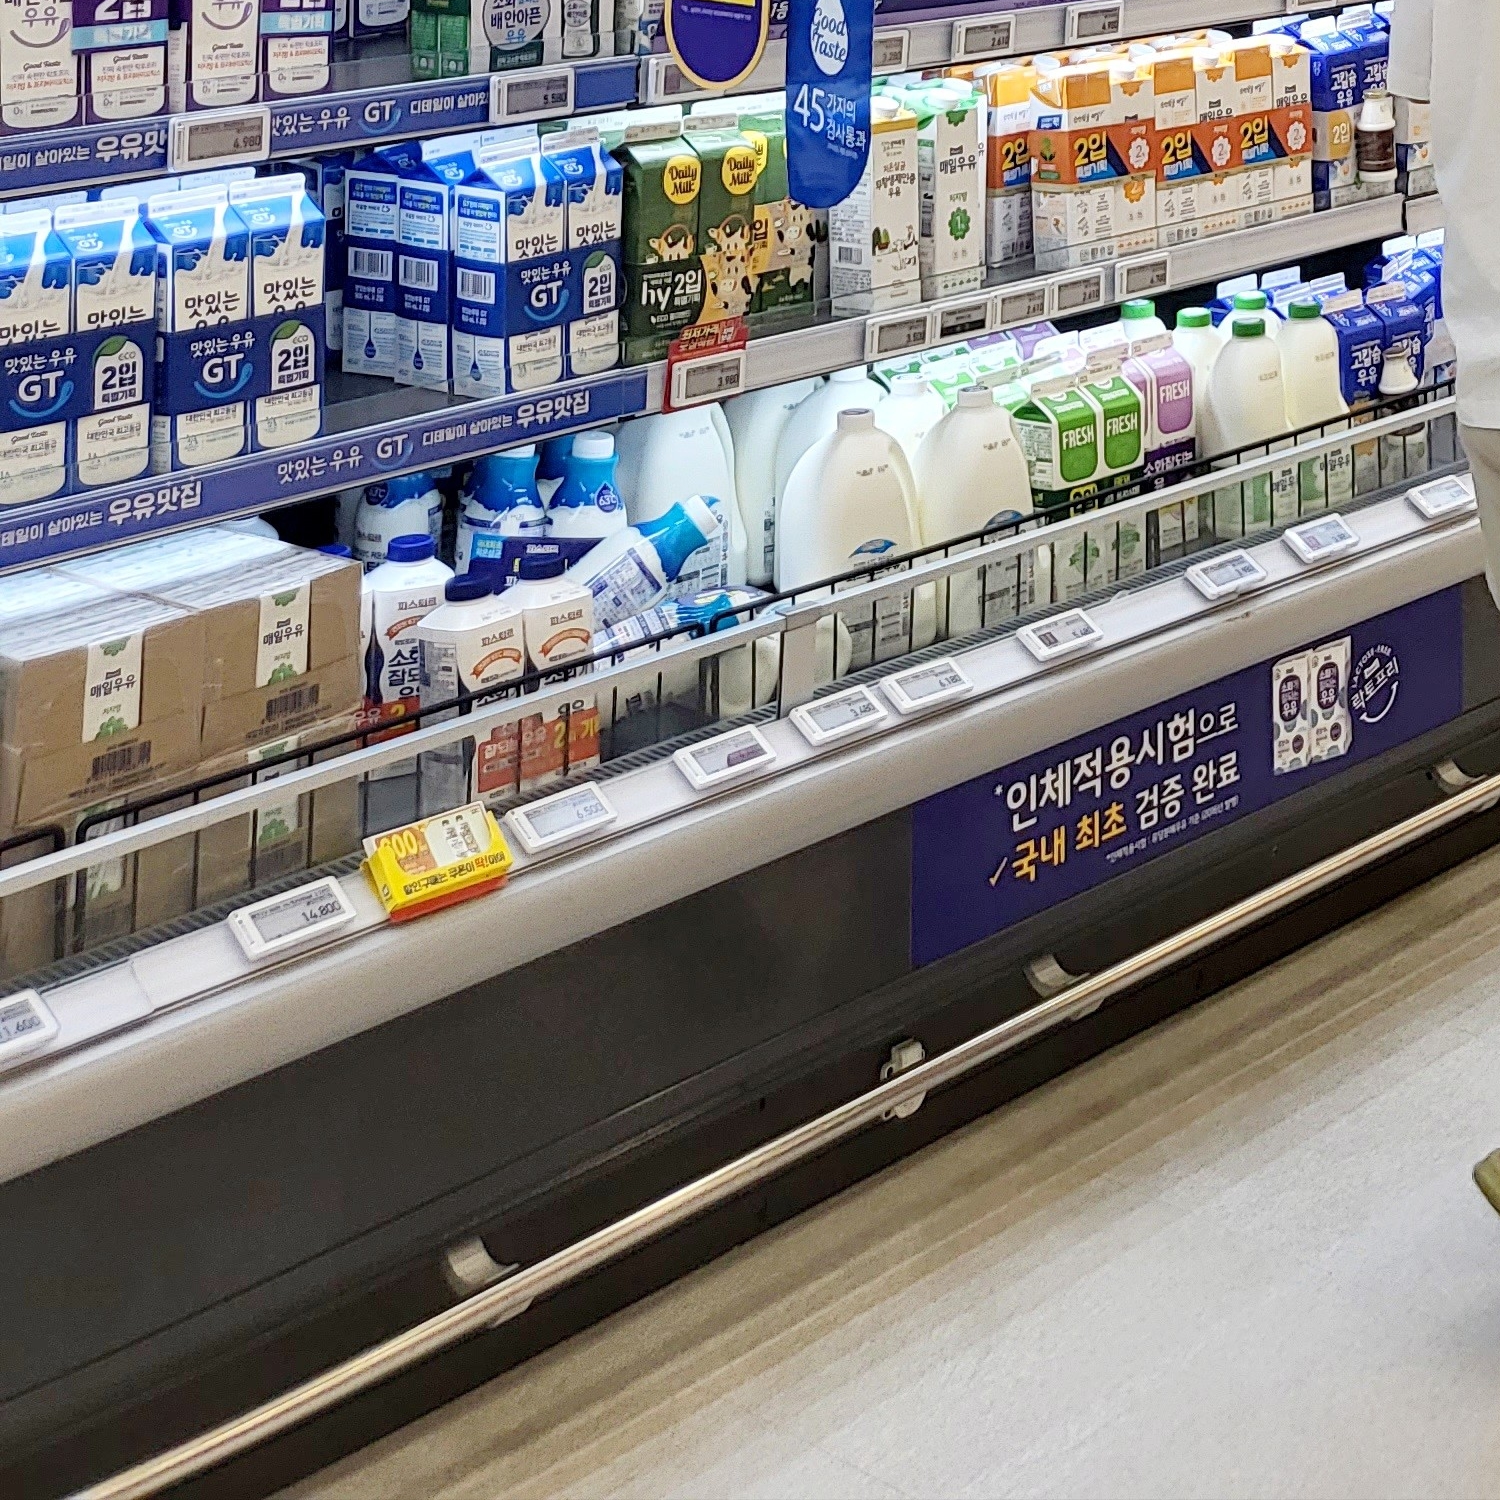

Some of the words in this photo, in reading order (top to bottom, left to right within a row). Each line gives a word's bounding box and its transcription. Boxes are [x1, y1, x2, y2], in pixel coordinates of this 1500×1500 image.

[812, 6, 846, 37] Good
[812, 31, 846, 63] Taste
[1331, 70, 1357, 91] 고칼슘
[317, 106, 351, 132] 우유
[364, 100, 397, 123] GT
[409, 94, 455, 116] 디테일이
[793, 82, 827, 135] 45
[826, 93, 857, 125] 가지의
[1161, 129, 1192, 165] 2입
[1239, 114, 1269, 150] 2입
[669, 165, 698, 183] Daily
[726, 156, 755, 174] Daily
[729, 171, 753, 187] Milk
[641, 282, 672, 312] hy
[190, 336, 230, 358] 맛있는
[230, 330, 256, 351] 우유
[4, 354, 47, 376] 맛있는
[49, 347, 77, 367] 우유
[1159, 379, 1190, 404] FRESH
[277, 455, 328, 485] 맛있는
[330, 445, 364, 472] 우유
[376, 433, 409, 459] GT
[422, 424, 467, 446] 디테일이
[469, 415, 513, 435] 살아있는
[516, 388, 590, 430] 우유맛집
[1062, 424, 1095, 451] FRESH
[1106, 412, 1138, 438] FRESH
[47, 511, 103, 537] 살아있는
[108, 481, 202, 526] 우유맛집
[263, 623, 304, 647] 매일우유
[90, 674, 136, 698] 매일우유
[1350, 656, 1399, 710] 락토프리
[1006, 702, 1239, 832] 인체적용시험으로
[1012, 825, 1066, 882] 국내
[1075, 801, 1127, 850] 최초
[1135, 774, 1185, 831] 검증
[1192, 750, 1241, 805] 완료
